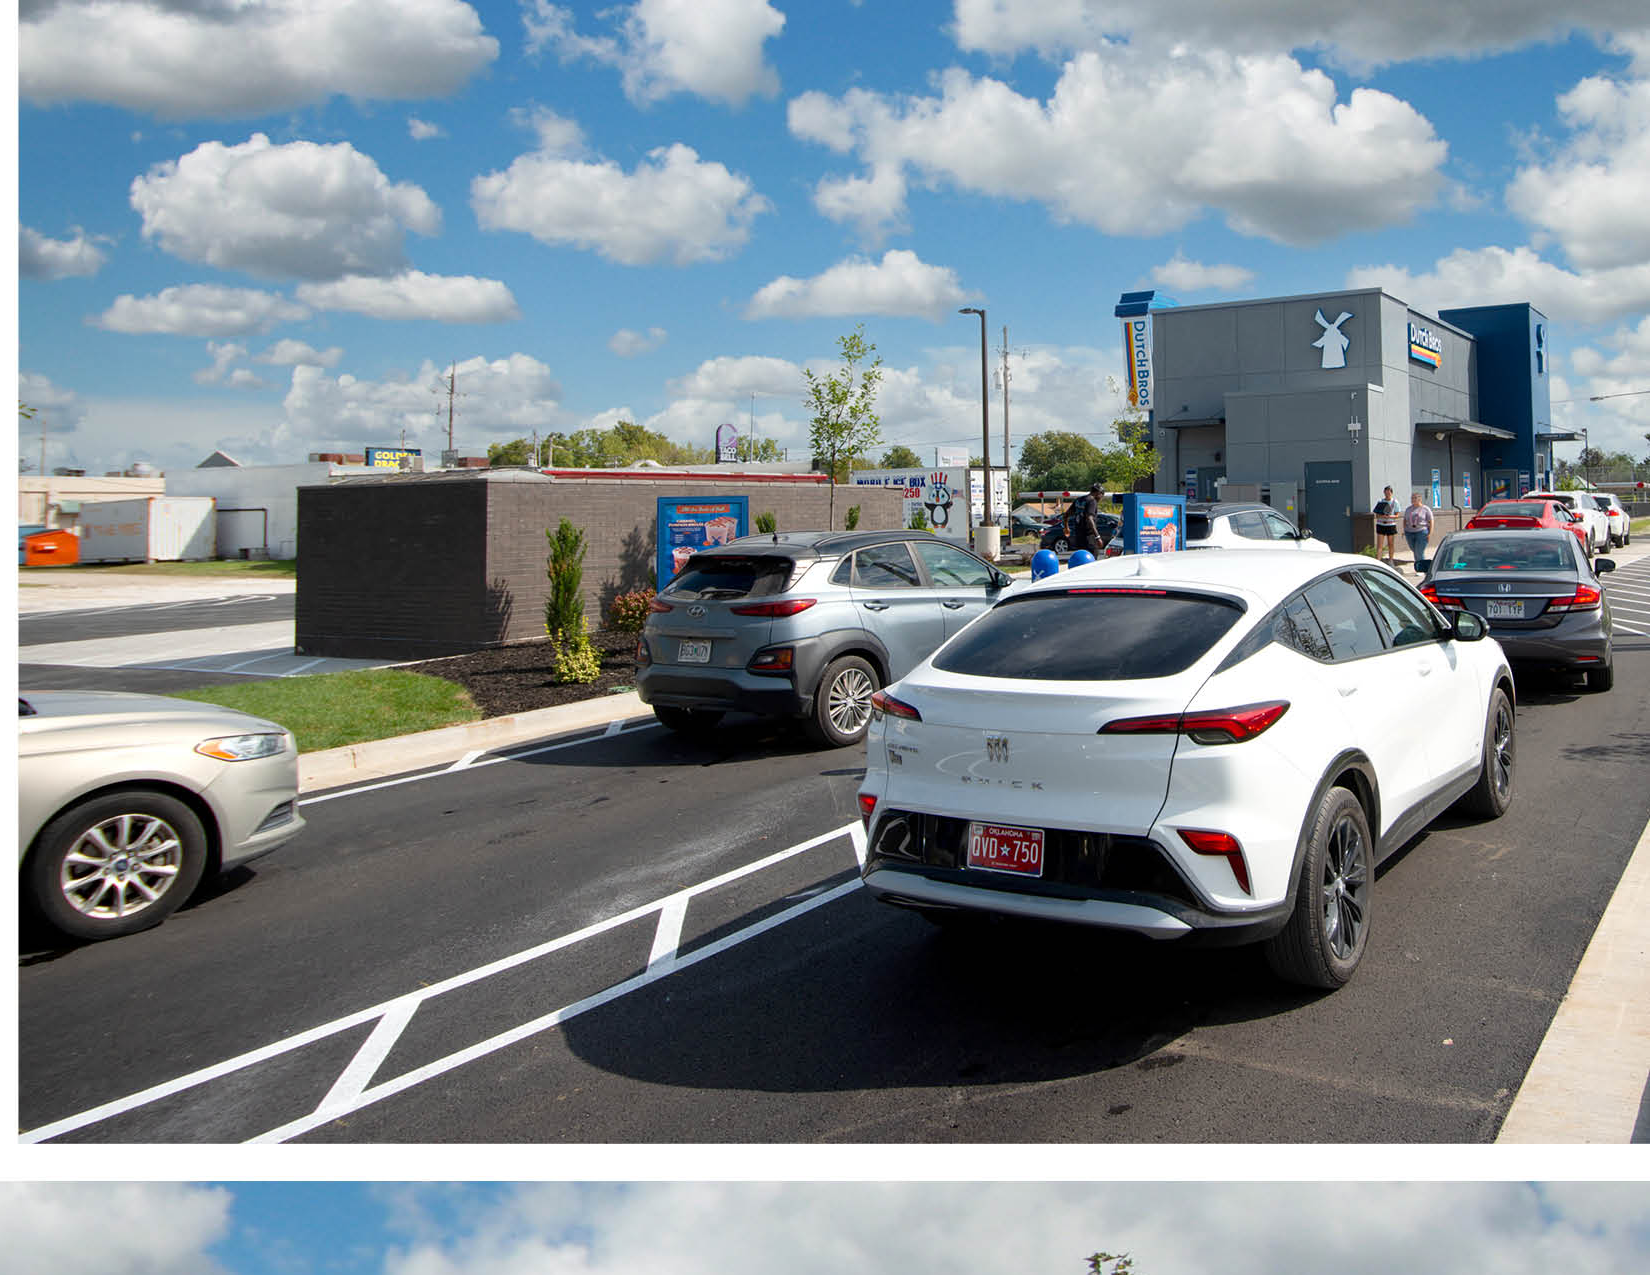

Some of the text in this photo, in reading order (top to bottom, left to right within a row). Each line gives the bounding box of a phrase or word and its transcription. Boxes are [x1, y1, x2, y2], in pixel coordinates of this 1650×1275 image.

[1134, 320, 1150, 406] DUTCH BROS
[989, 827, 1023, 838] OKLAHOMA
[972, 835, 1039, 864] QVD 750
